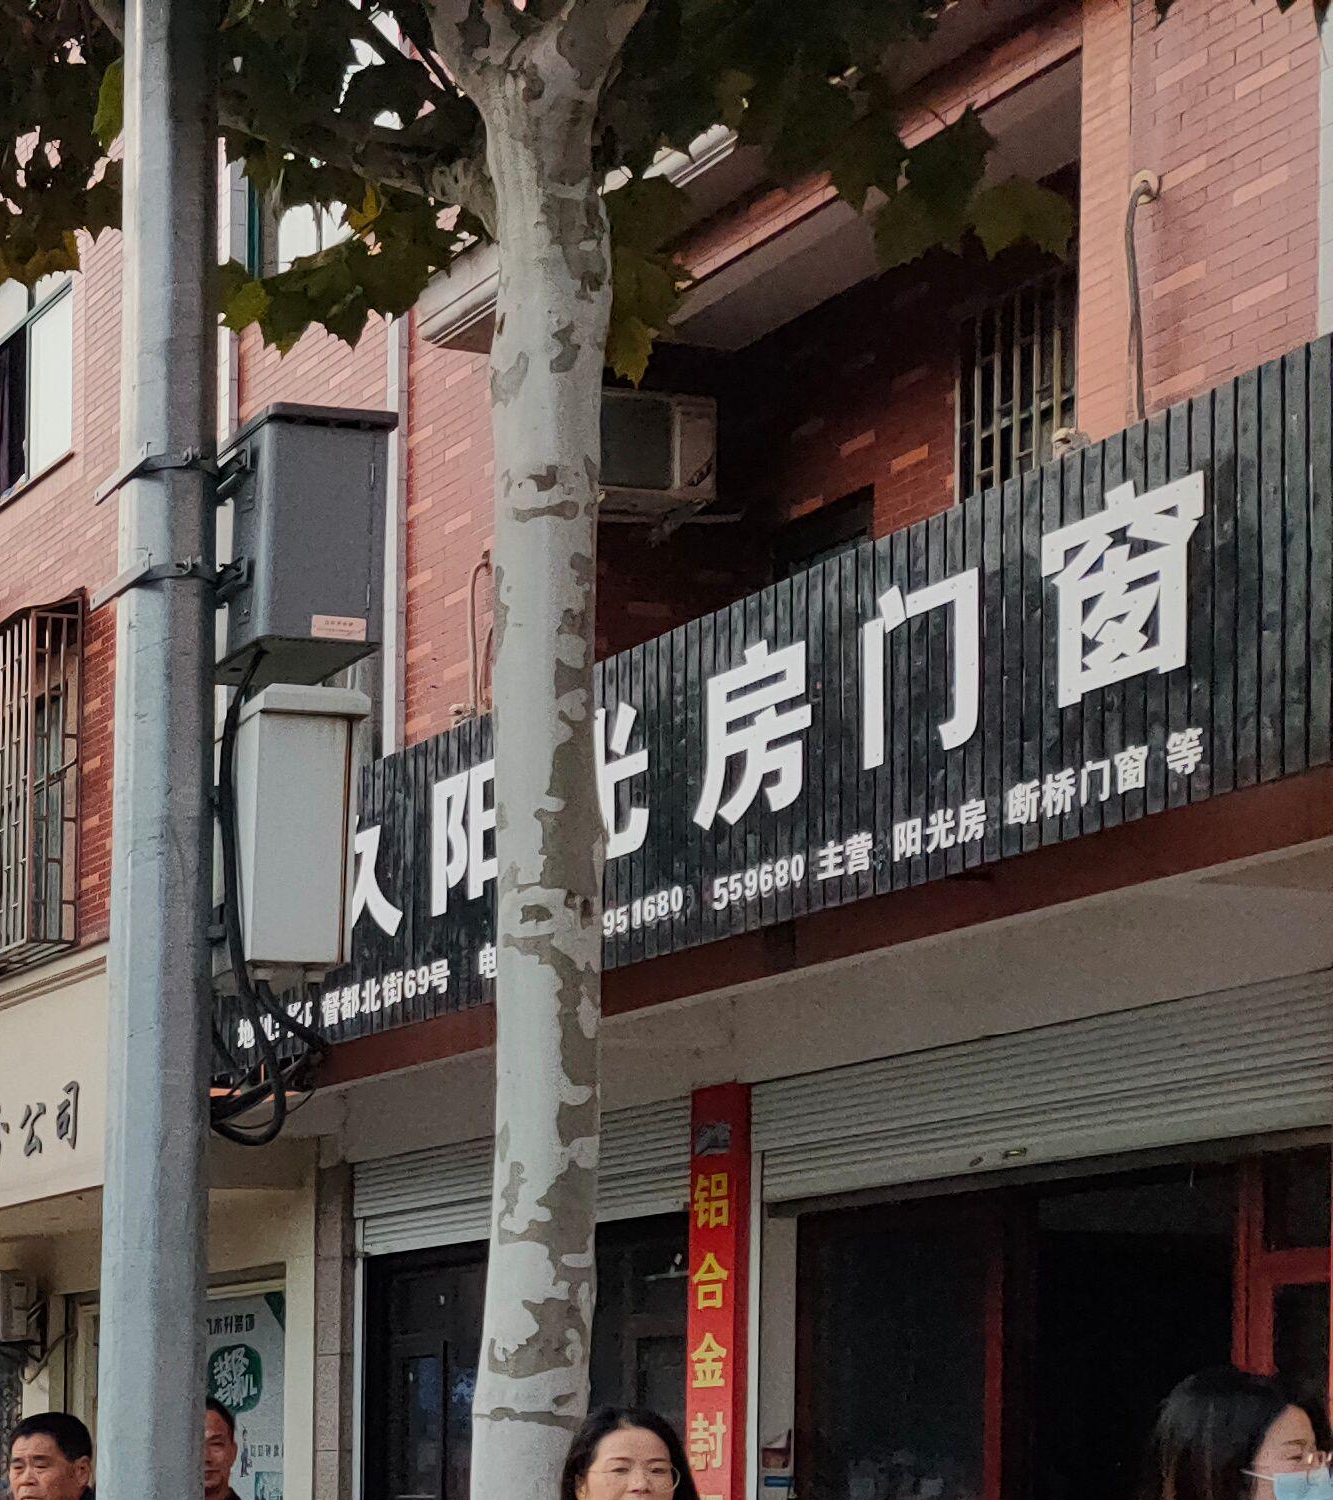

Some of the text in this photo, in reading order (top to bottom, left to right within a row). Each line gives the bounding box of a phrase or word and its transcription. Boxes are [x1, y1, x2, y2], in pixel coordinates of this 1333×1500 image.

[712, 853, 806, 911] 559680
[817, 832, 874, 881] 主营
[892, 798, 988, 862] 阳光房
[1007, 744, 1149, 825] 断桥门窗
[1165, 727, 1205, 775] 等
